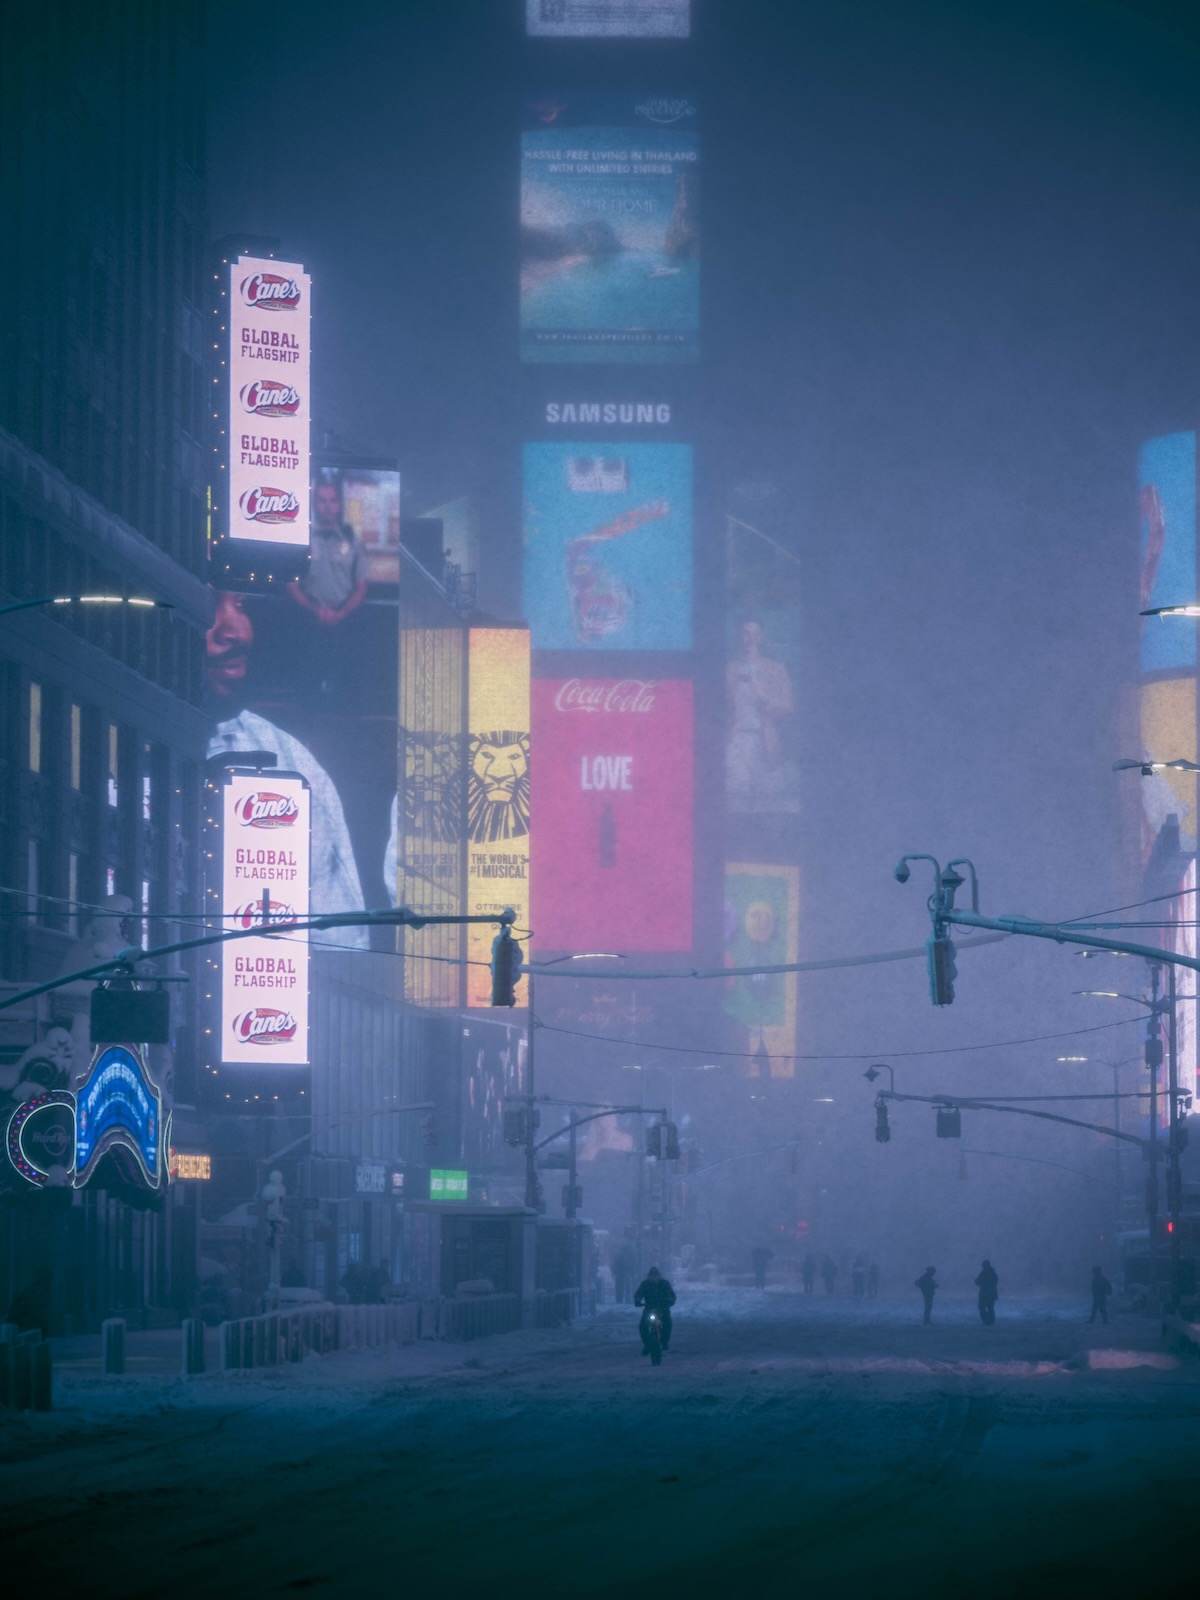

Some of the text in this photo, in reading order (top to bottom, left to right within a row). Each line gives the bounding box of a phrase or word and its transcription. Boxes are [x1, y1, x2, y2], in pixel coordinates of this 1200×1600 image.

[549, 163, 574, 174] WITH
[241, 273, 301, 306] Cane's
[241, 328, 299, 349] GLOBAL
[241, 345, 299, 363] FLAGSHIP
[240, 380, 300, 413] Cane's
[545, 402, 671, 424] SAMSUNG
[241, 435, 298, 456] GLOBAL
[240, 452, 299, 470] FLAGSHIP
[239, 488, 299, 520] Cane's
[581, 755, 633, 791] LOVE
[234, 793, 299, 827] Cane's
[236, 849, 297, 866] GLOBAL
[471, 853, 488, 865] THE
[489, 853, 527, 865] WORLD'S
[235, 866, 297, 881] FLAGSHIP
[482, 865, 528, 879] MUSICAL
[235, 957, 296, 974] GLOBAL
[234, 974, 297, 988] FLAGSHIP
[233, 1009, 297, 1043] Cane's
